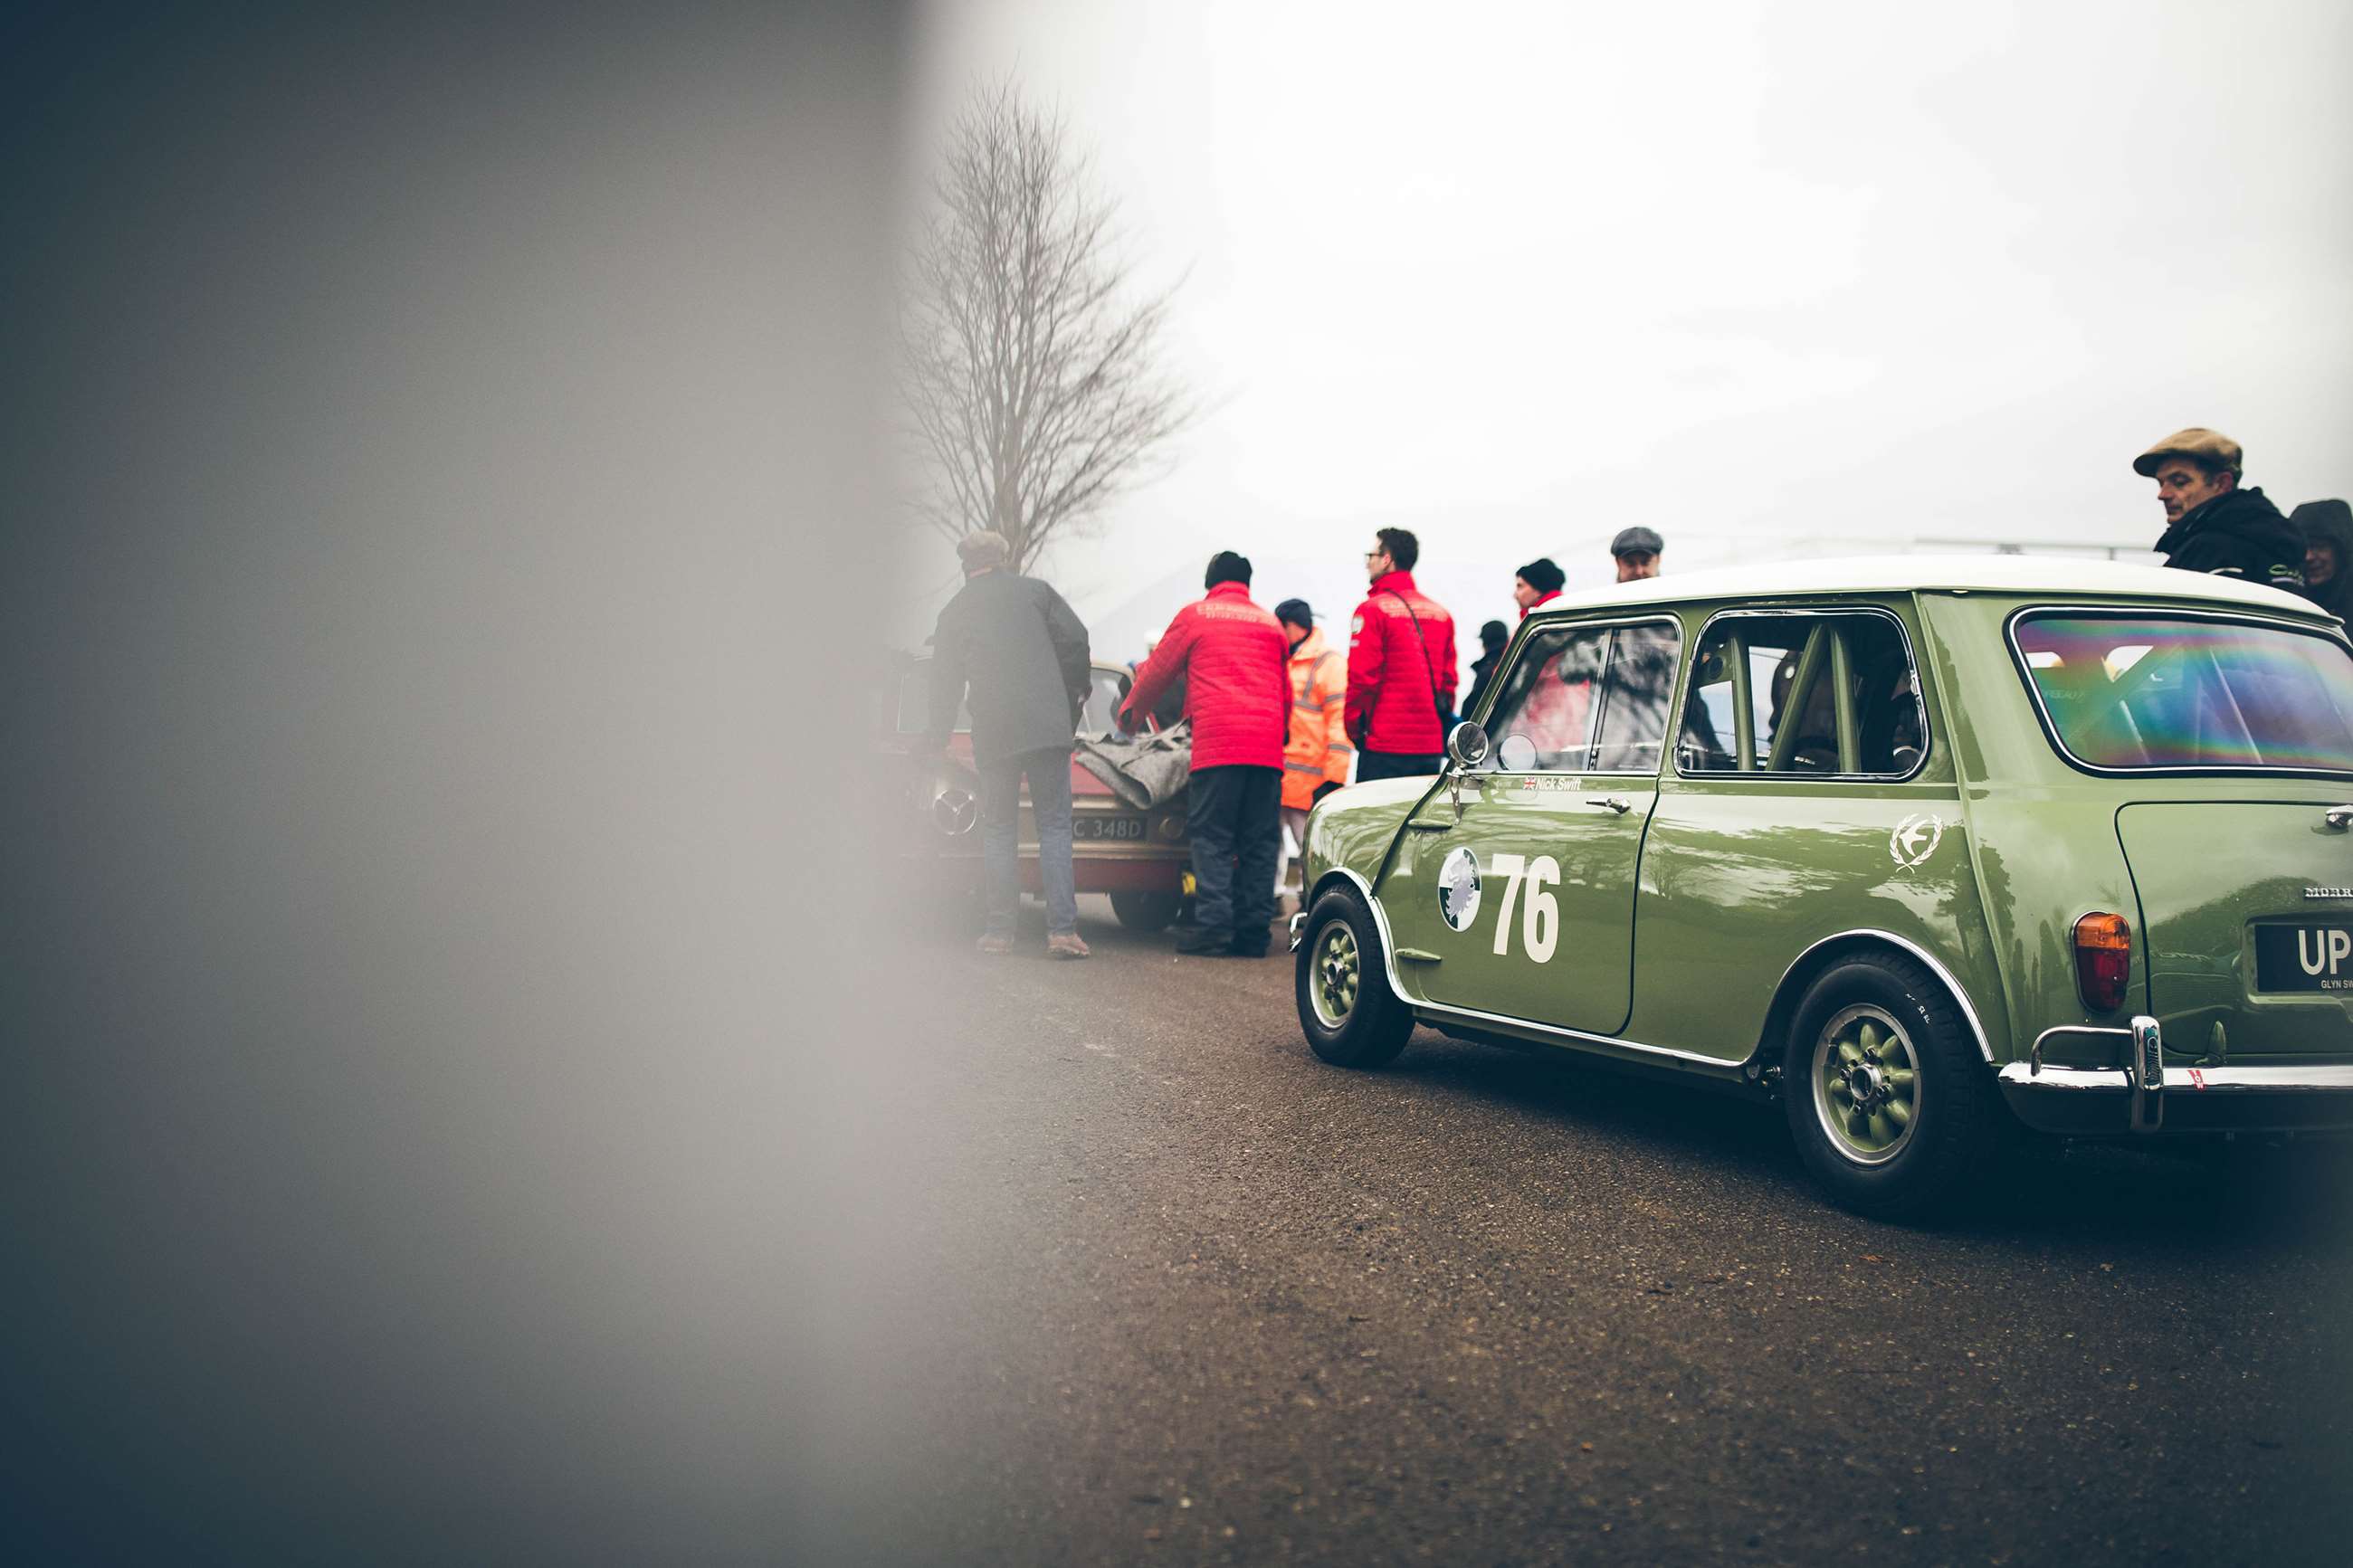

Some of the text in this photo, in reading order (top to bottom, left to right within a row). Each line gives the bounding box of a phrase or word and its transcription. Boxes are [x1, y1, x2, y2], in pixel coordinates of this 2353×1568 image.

[1535, 777, 1582, 791] Nick Swift
[1092, 819, 1142, 838] 348D
[1491, 853, 1561, 964] 76
[2298, 929, 2351, 975] UP
[2320, 979, 2341, 989] GLYN
